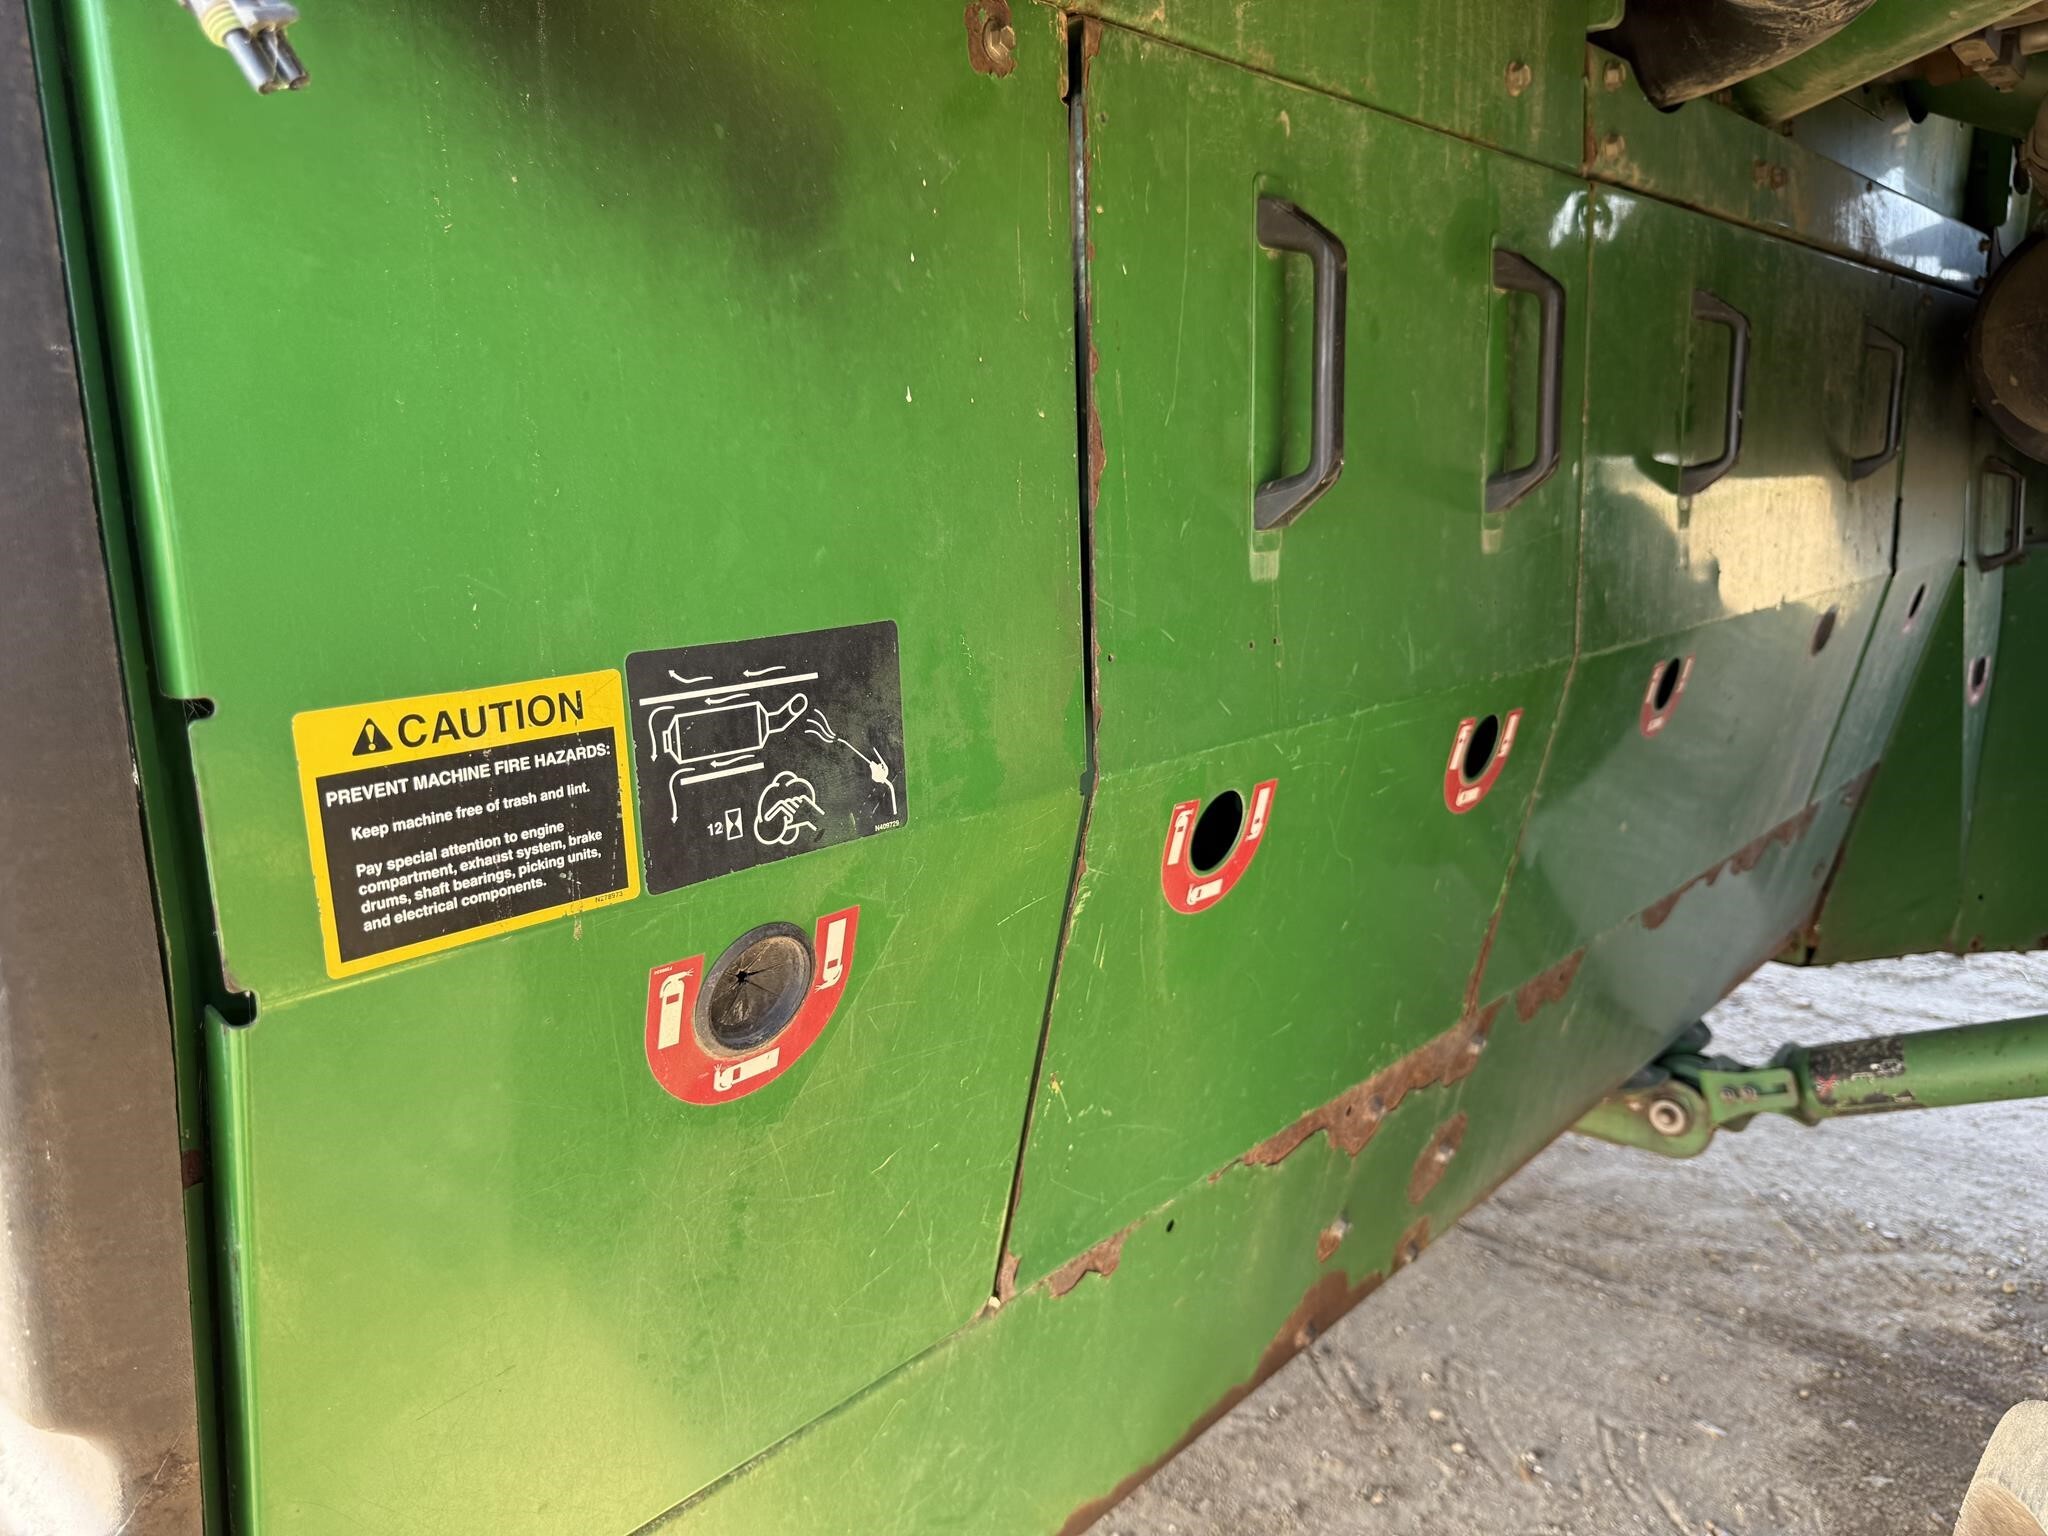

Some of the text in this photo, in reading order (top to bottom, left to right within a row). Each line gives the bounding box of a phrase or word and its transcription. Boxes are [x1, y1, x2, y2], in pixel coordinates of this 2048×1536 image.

[398, 690, 585, 748] CAUTION
[325, 743, 611, 808] PREVENT MACHINE FIRE HAZARDS:
[351, 782, 591, 841] Keep machine free of trash and lint.
[707, 822, 723, 836] 12
[356, 822, 564, 879] Pay special attention to engine
[358, 830, 603, 897] compartment, exhaust system, brake
[360, 847, 602, 914] drums, shaft bearings, picking units,
[363, 878, 547, 932] and electrical components.
